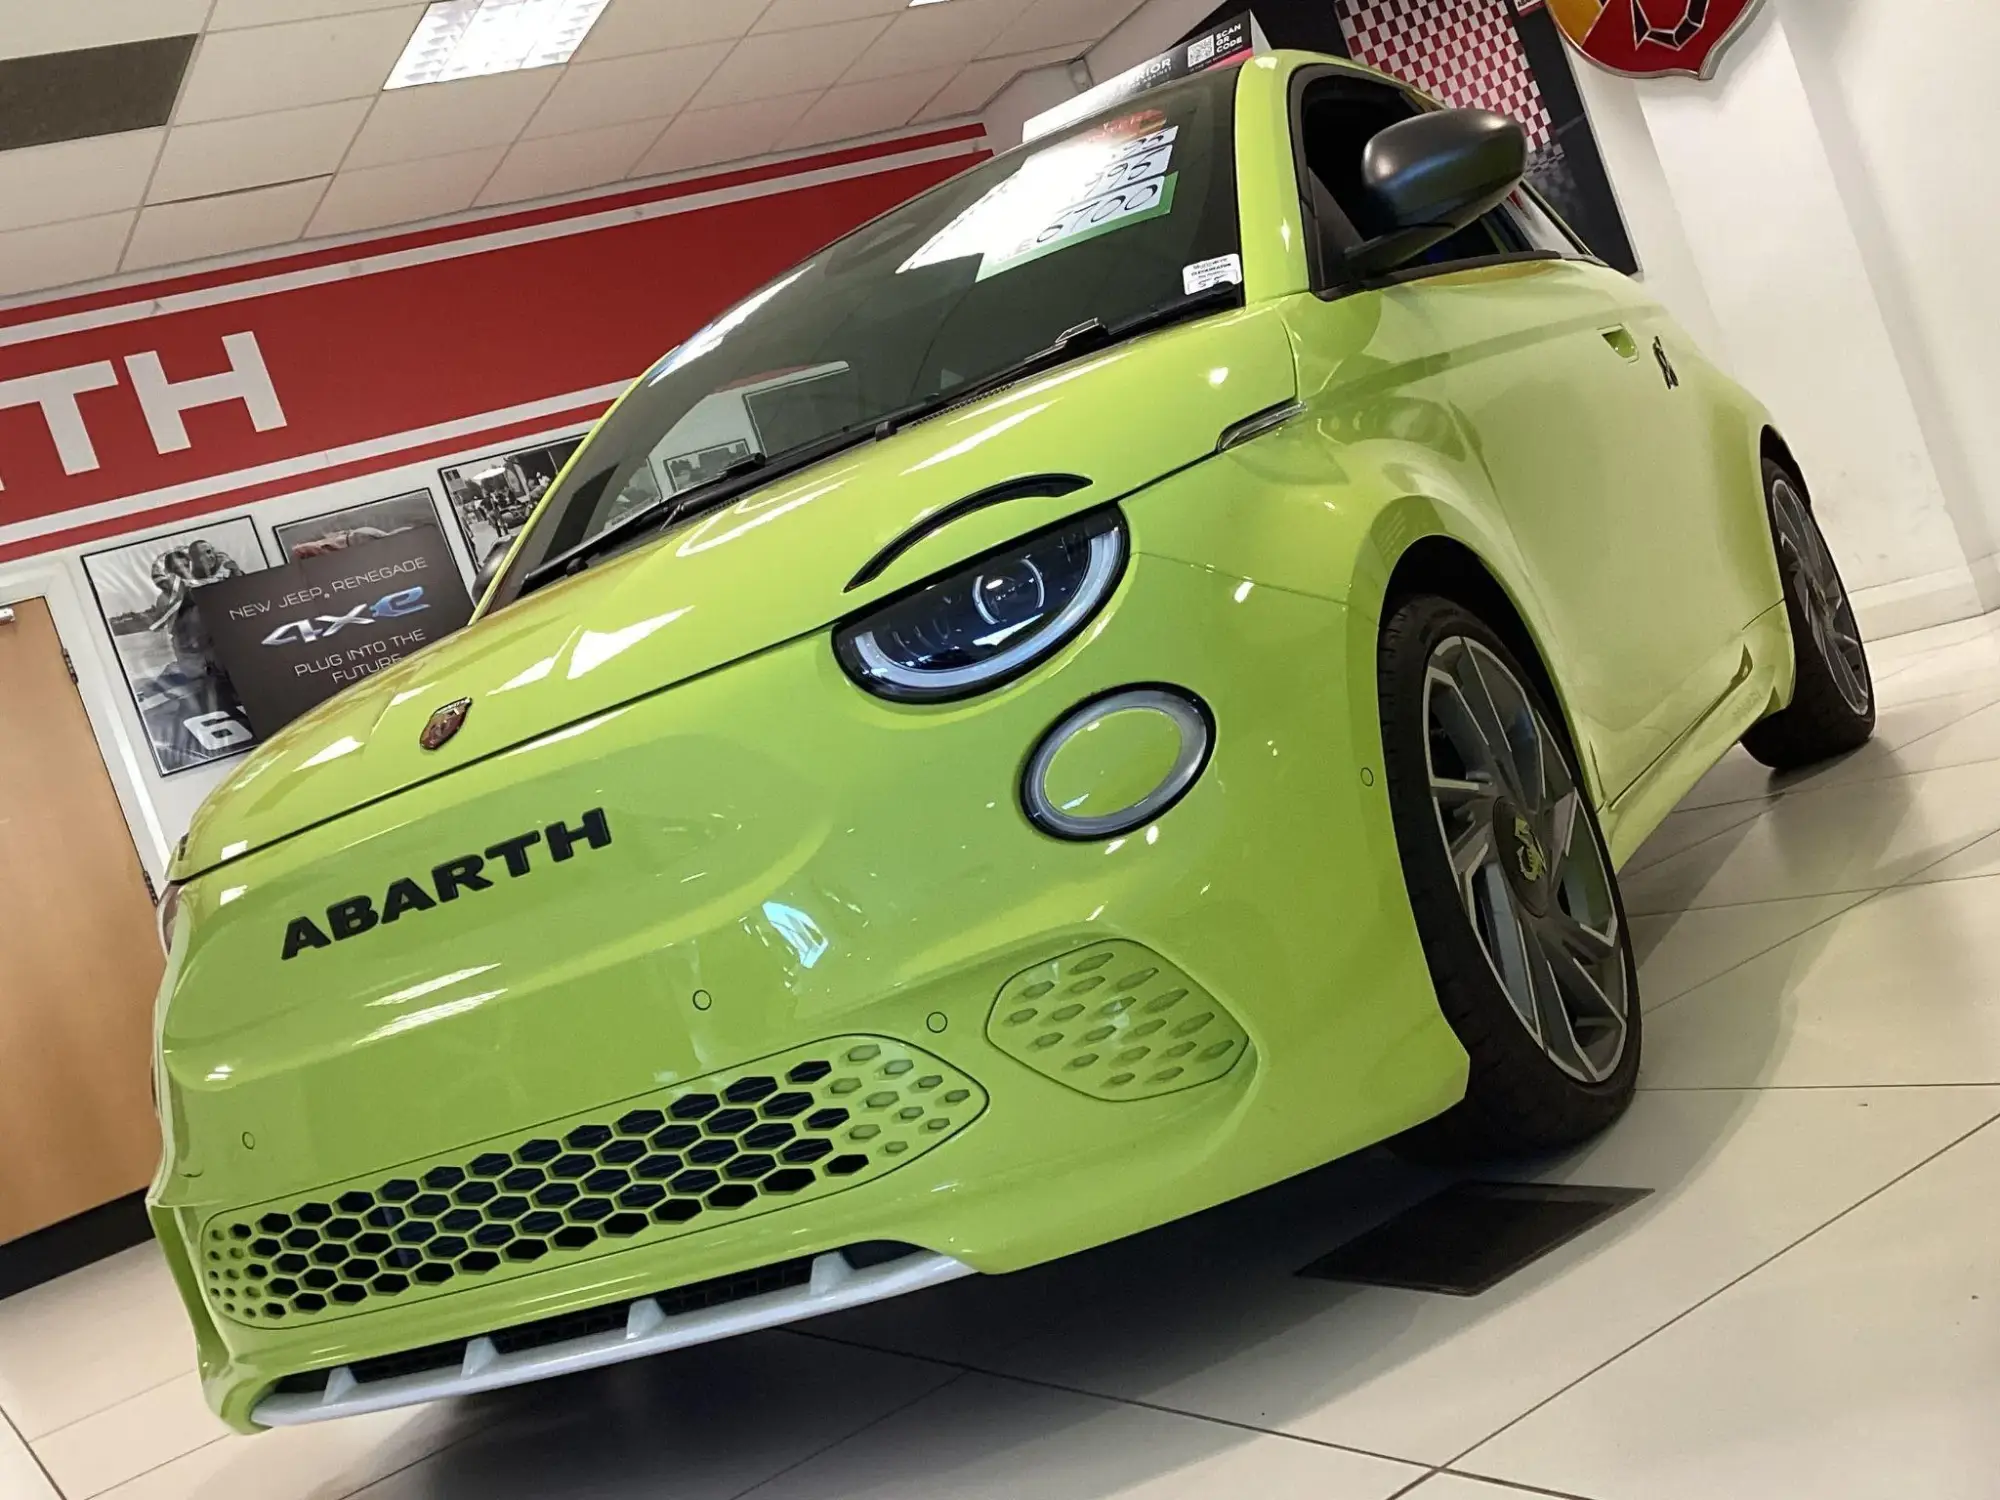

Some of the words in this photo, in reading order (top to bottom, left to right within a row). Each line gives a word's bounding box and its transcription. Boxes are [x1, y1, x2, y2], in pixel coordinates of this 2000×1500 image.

[1216, 23, 1241, 40] SCAN
[1216, 36, 1242, 53] CODE
[229, 600, 271, 621] NEW
[331, 557, 429, 593] RENEGADE
[294, 653, 343, 677] PLUG
[346, 640, 386, 662] INTO
[391, 629, 426, 648] THE
[281, 807, 612, 960] ABARTH
